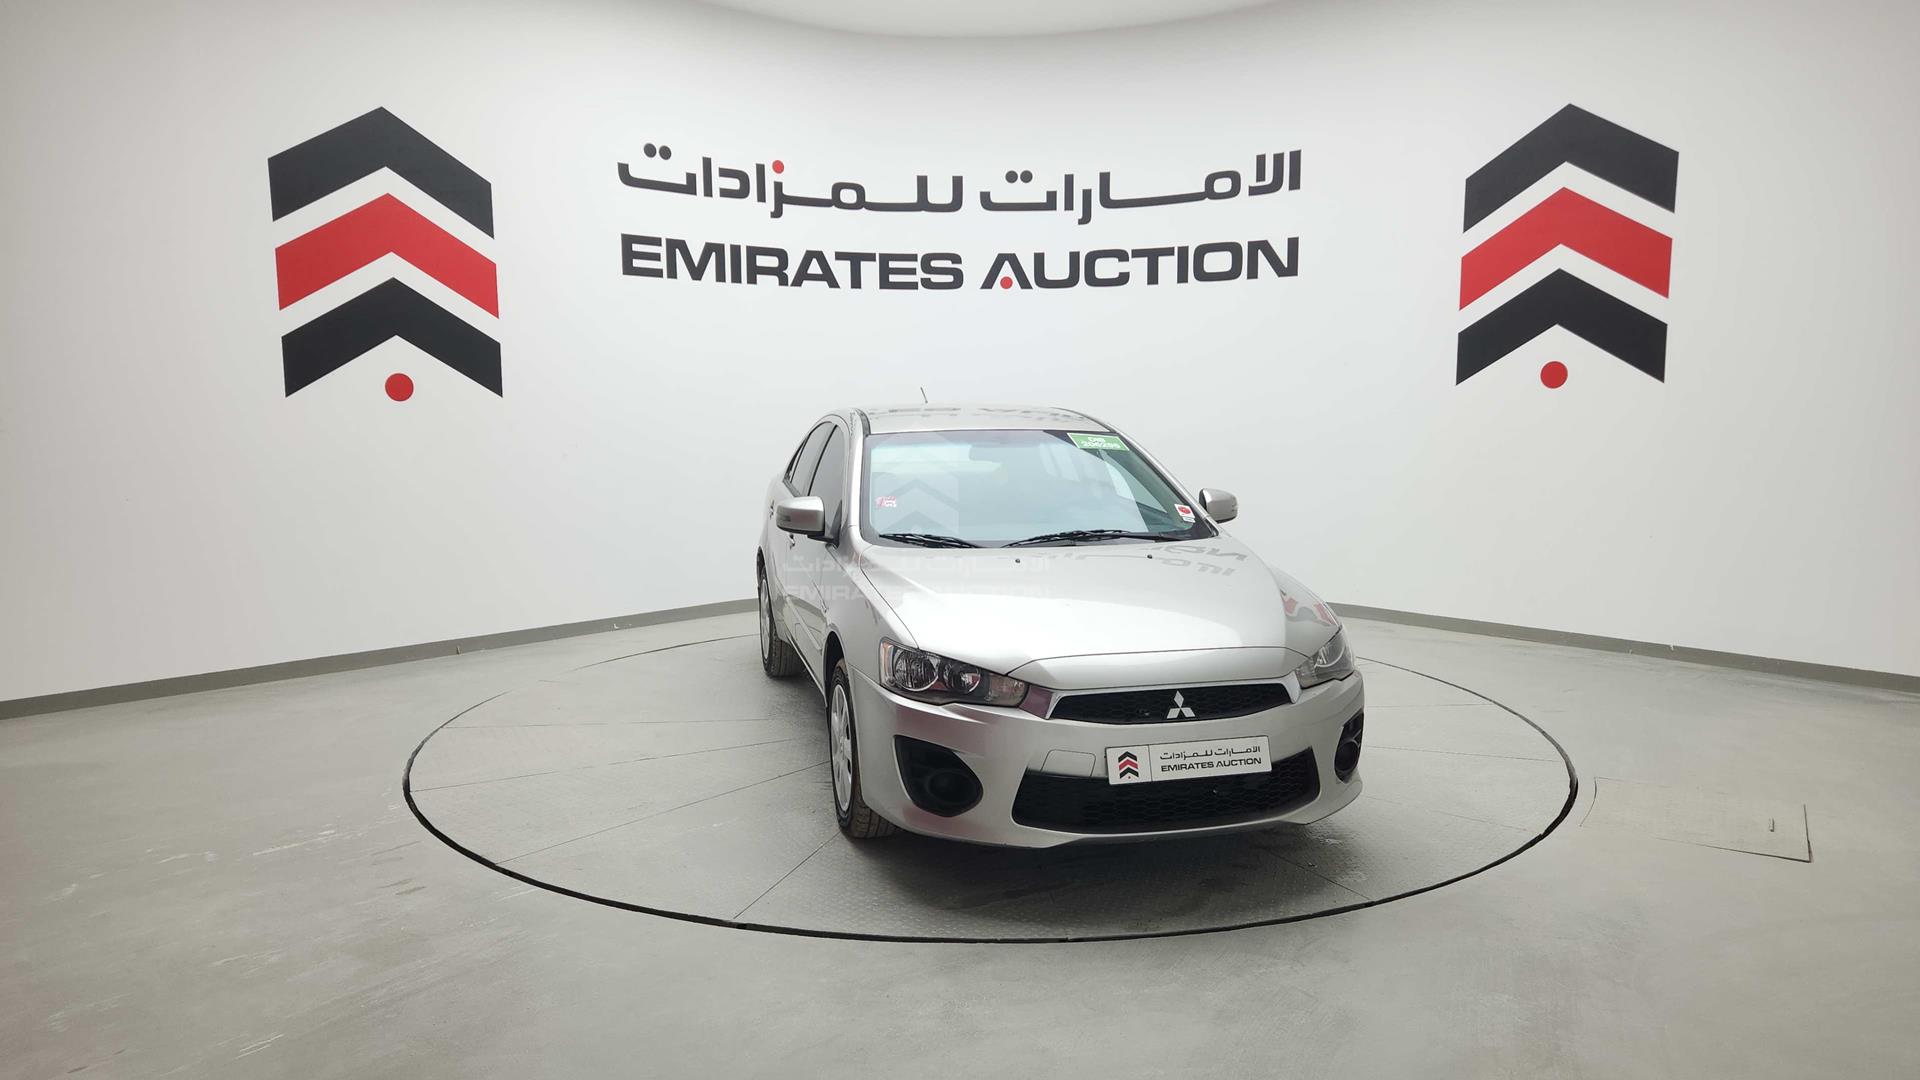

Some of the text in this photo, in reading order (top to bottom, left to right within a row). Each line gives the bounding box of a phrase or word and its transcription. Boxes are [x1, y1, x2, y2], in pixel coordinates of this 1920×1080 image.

[617, 143, 1302, 226] الامارات للمزادات
[620, 233, 1300, 290] EMIRATES AUCTION
[1159, 746, 1260, 760] الامارات للمزادات
[1160, 757, 1262, 772] EMIRATES AUCTION
